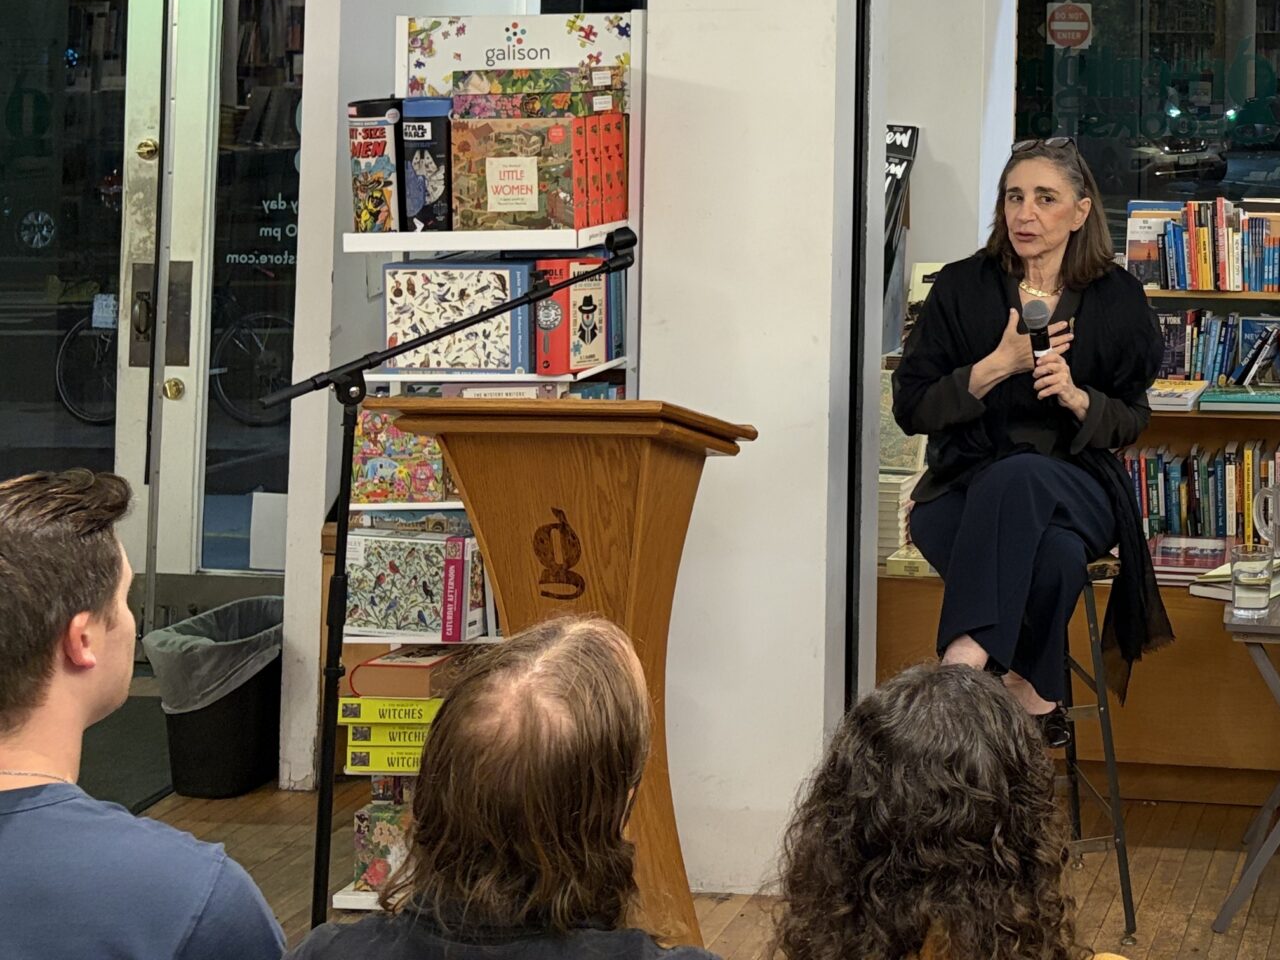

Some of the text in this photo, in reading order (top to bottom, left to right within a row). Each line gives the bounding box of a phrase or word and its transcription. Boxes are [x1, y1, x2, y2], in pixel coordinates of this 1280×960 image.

[1055, 11, 1083, 20] DO NOT
[1057, 31, 1081, 40] ENTER
[485, 43, 551, 66] galison
[499, 170, 525, 180] LITTLE
[491, 185, 533, 195] WOMEN
[446, 565, 455, 602] AFTERNOON
[378, 708, 423, 720] WITCHES
[388, 731, 426, 742] WITCHE
[387, 756, 419, 768] WITCH
